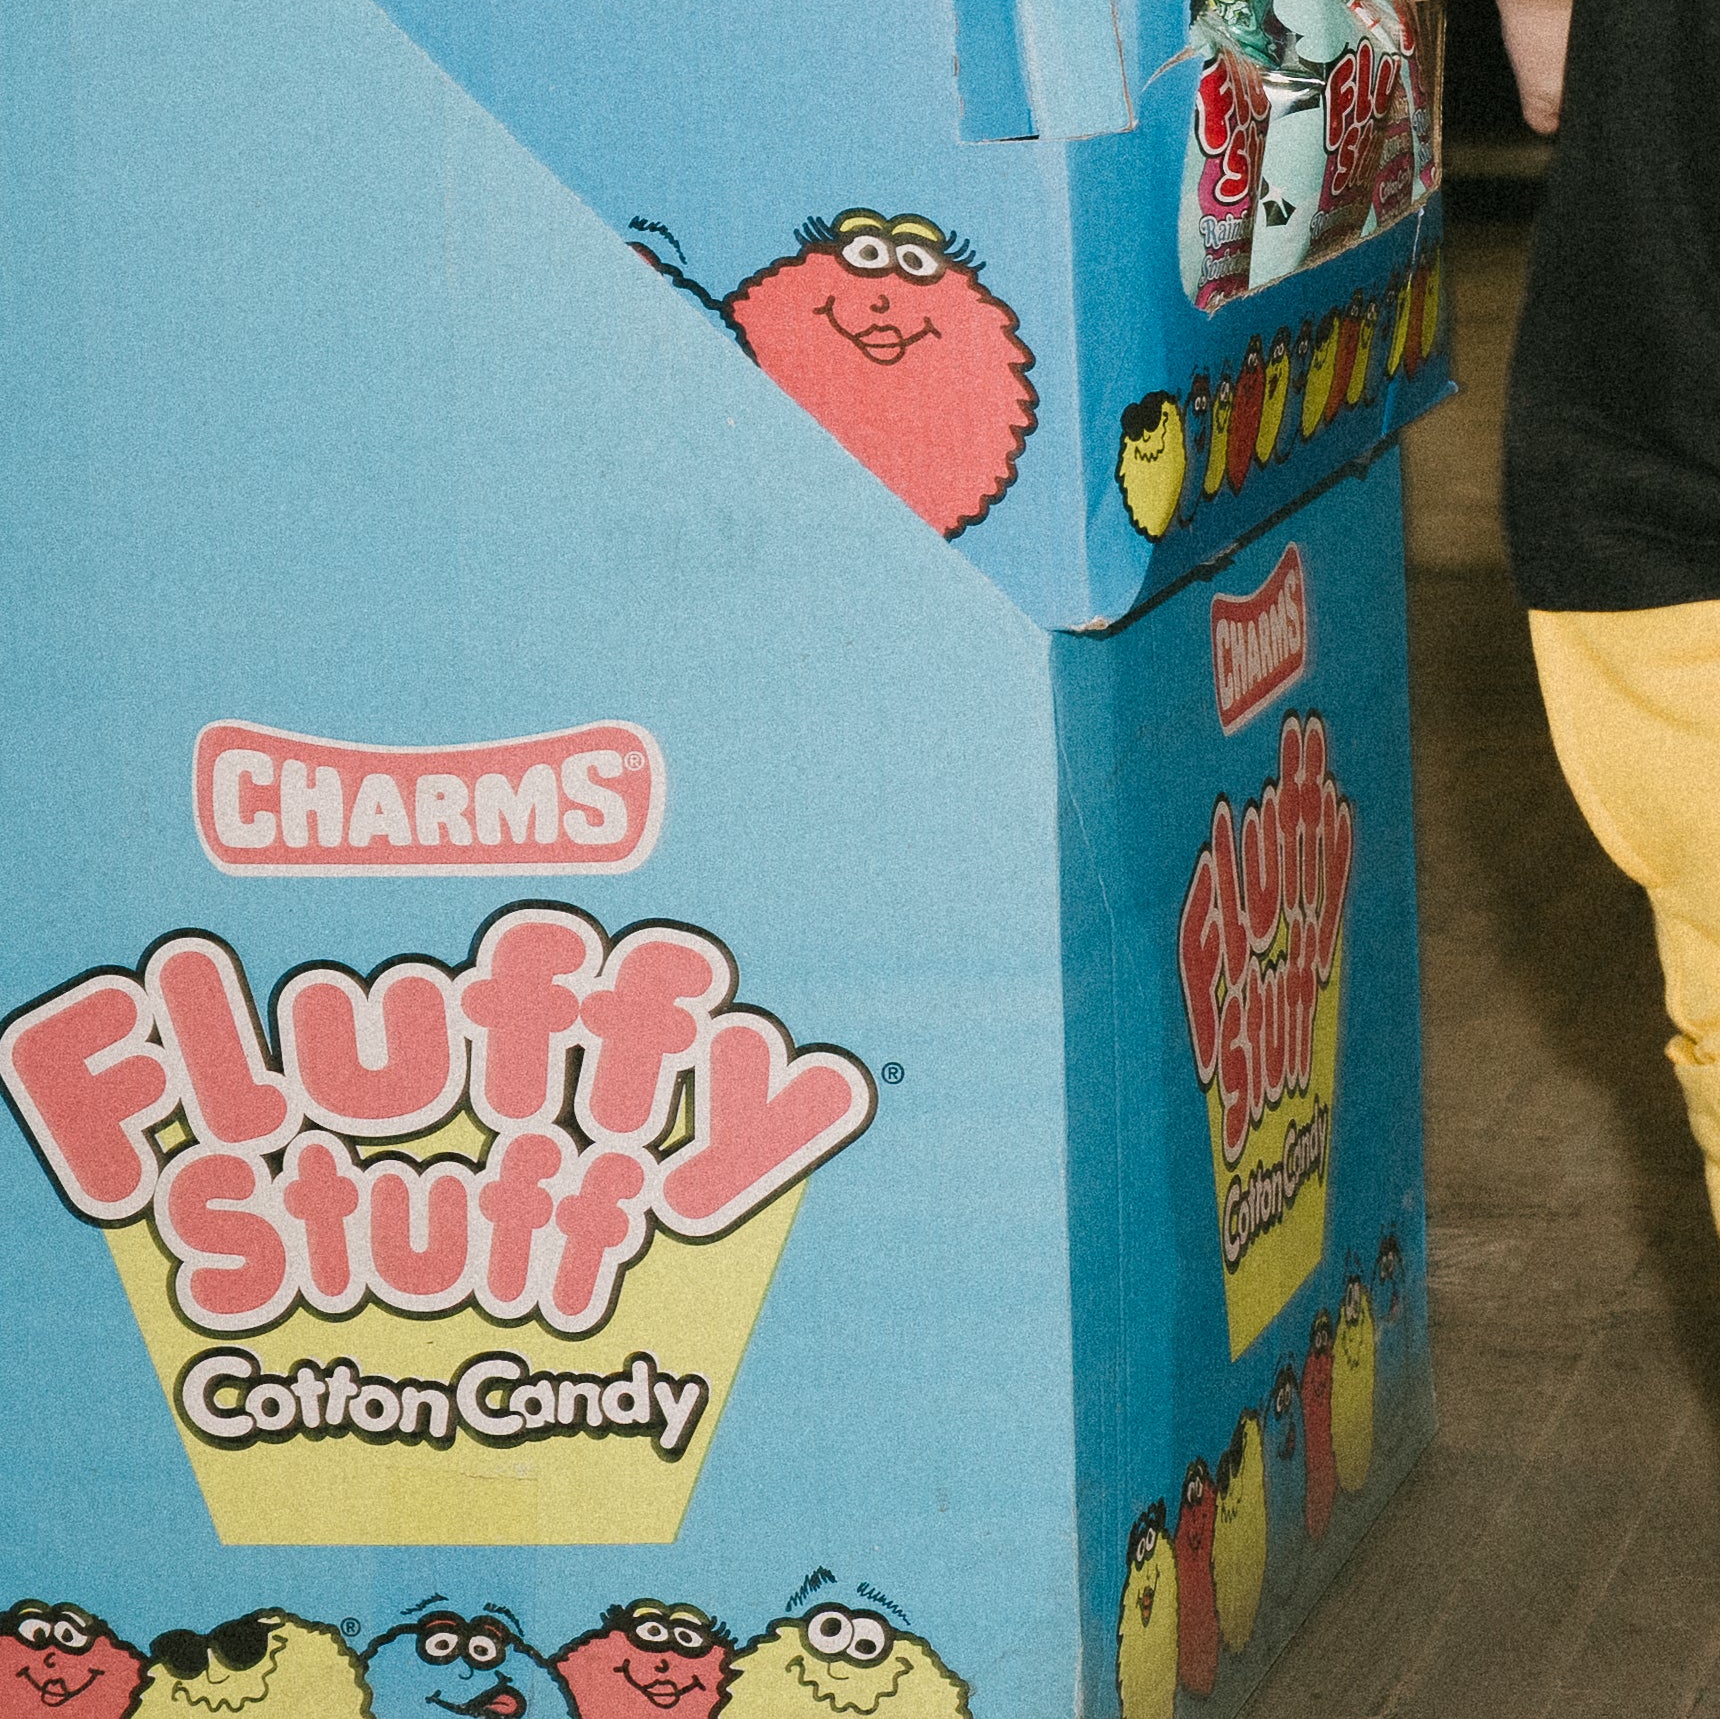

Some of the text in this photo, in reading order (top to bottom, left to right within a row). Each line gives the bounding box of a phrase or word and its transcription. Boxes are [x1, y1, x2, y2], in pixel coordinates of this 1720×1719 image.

[1178, 711, 1353, 1086] Fluffy
[0, 902, 877, 1244] Fluffy
[1218, 916, 1318, 1164] Stuff
[154, 1123, 649, 1336] Stuff
[1225, 1101, 1329, 1264] Cotton Candy
[182, 1353, 704, 1453] Cotton Candy
